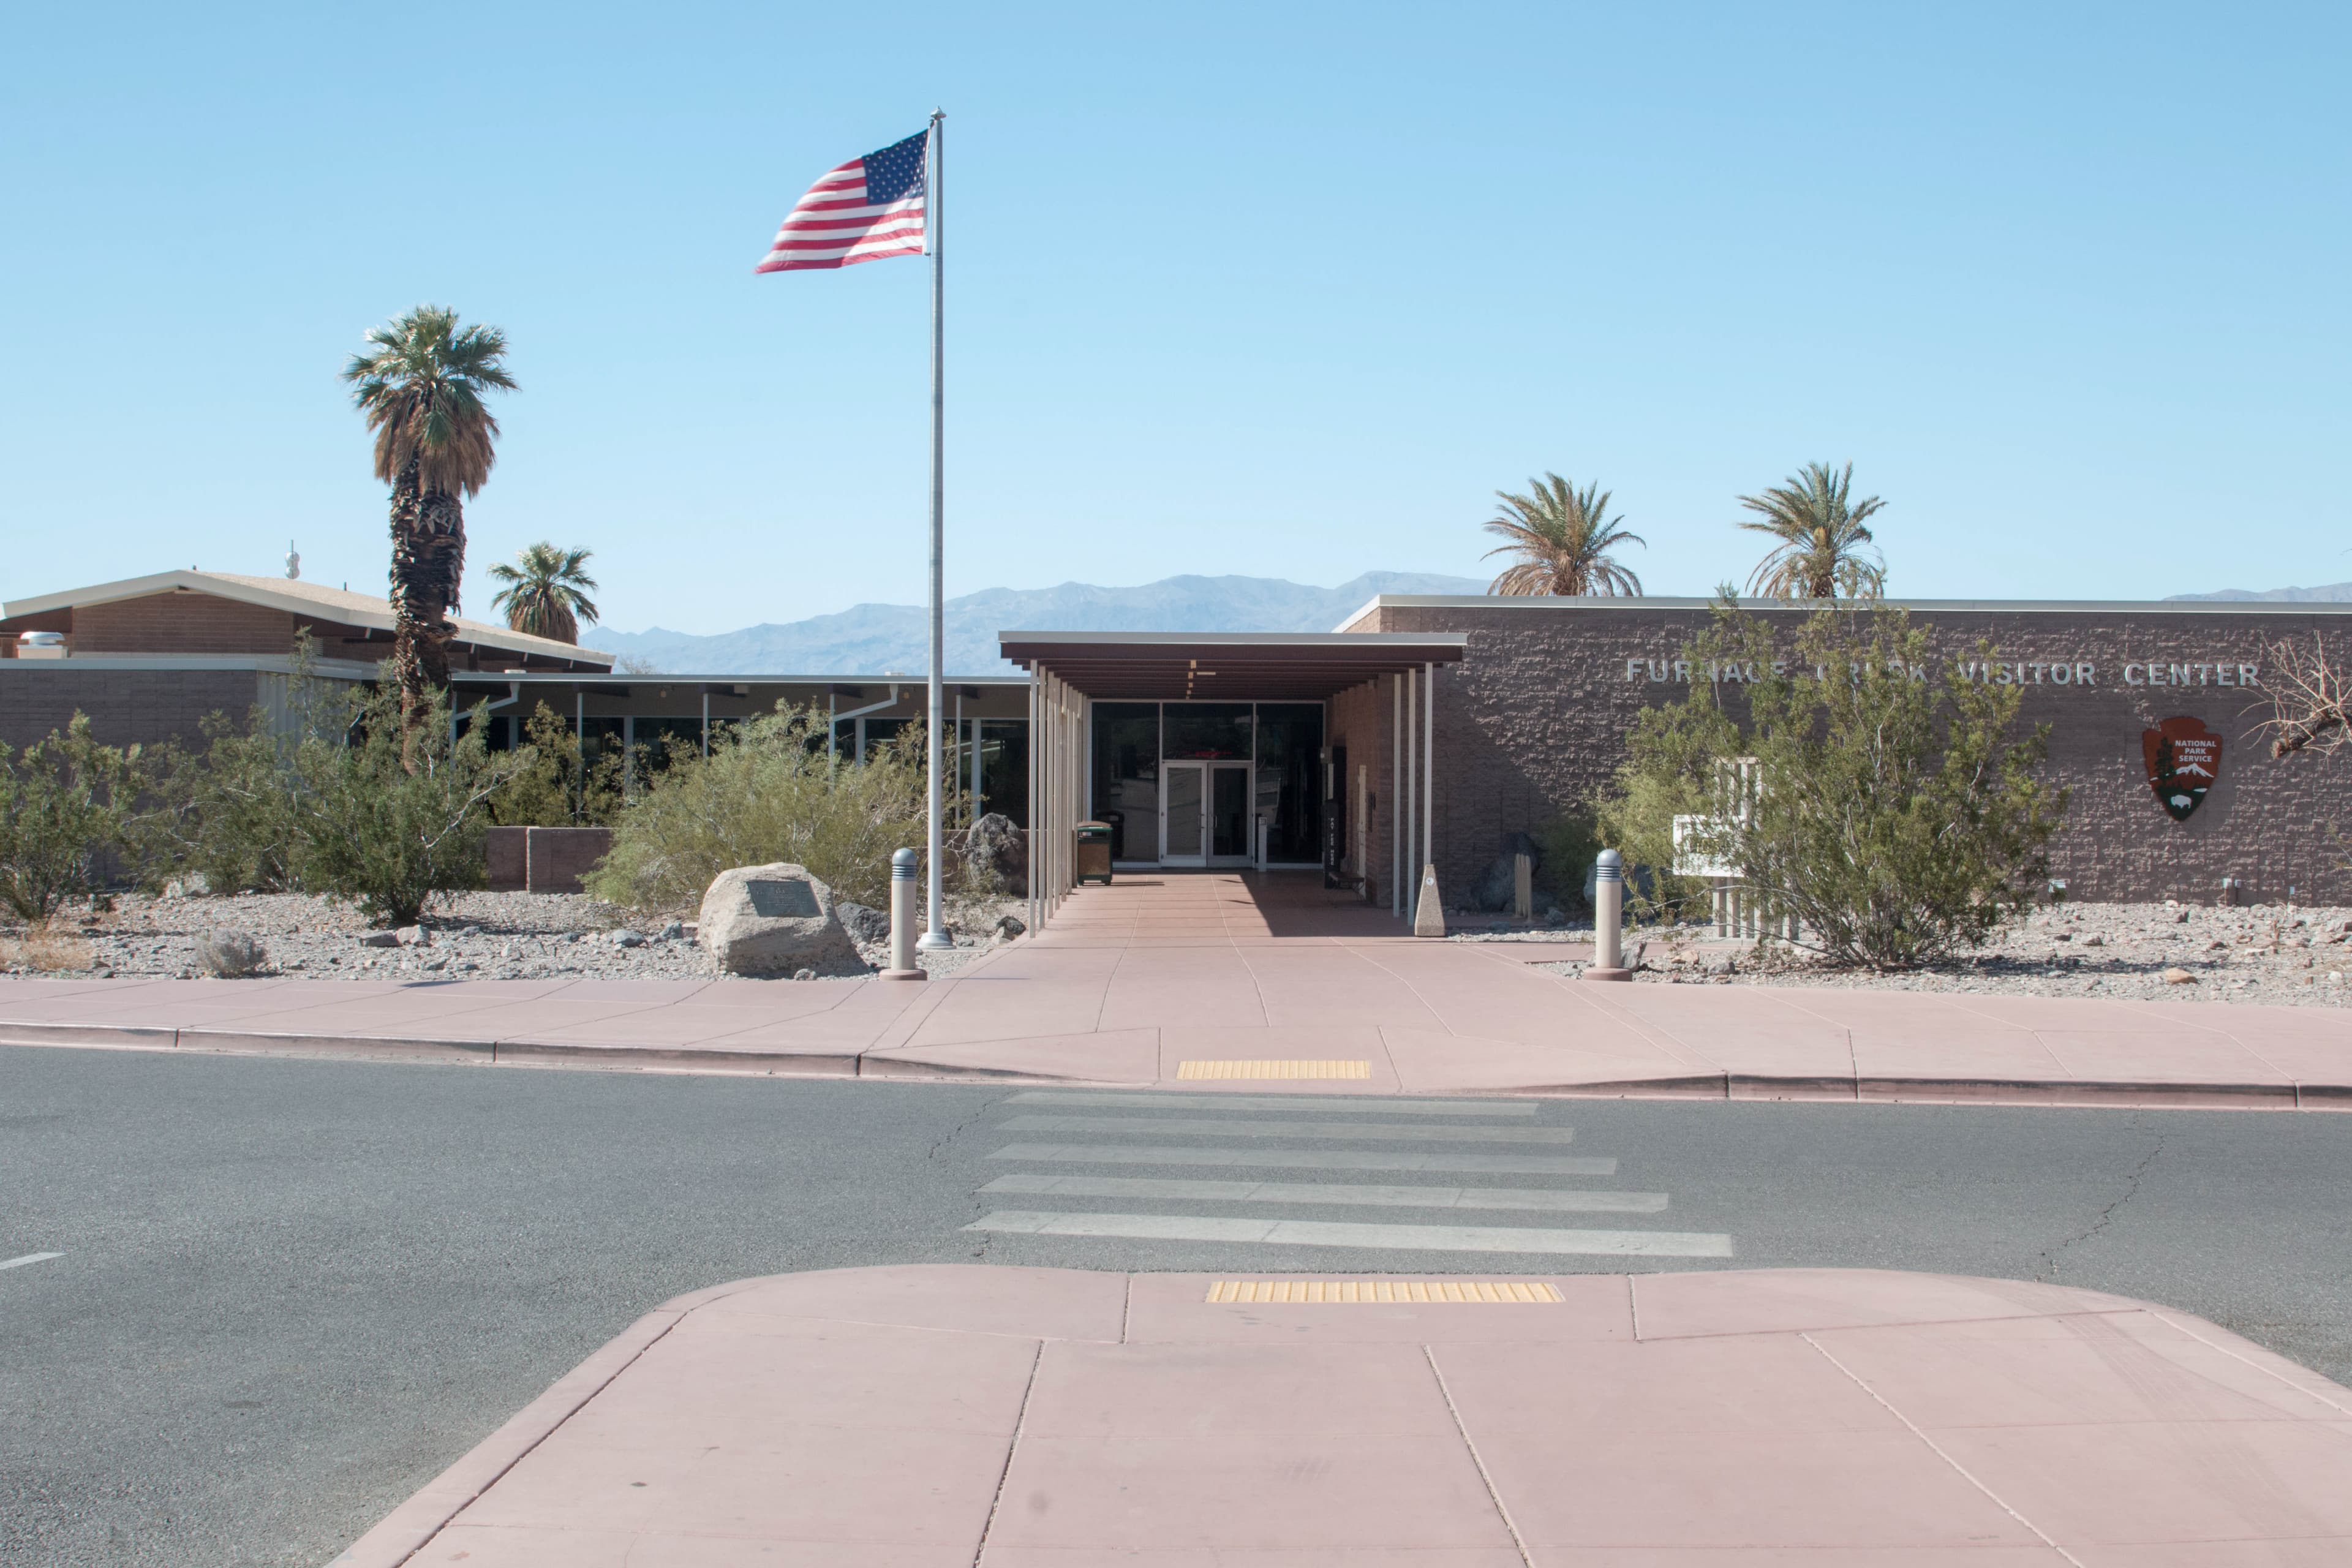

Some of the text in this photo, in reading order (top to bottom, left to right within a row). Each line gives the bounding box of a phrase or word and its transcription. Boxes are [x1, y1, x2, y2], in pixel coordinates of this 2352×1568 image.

[1817, 661, 1929, 684] REK
[1957, 662, 2096, 685] VISITOR
[2124, 663, 2259, 687] CENTER
